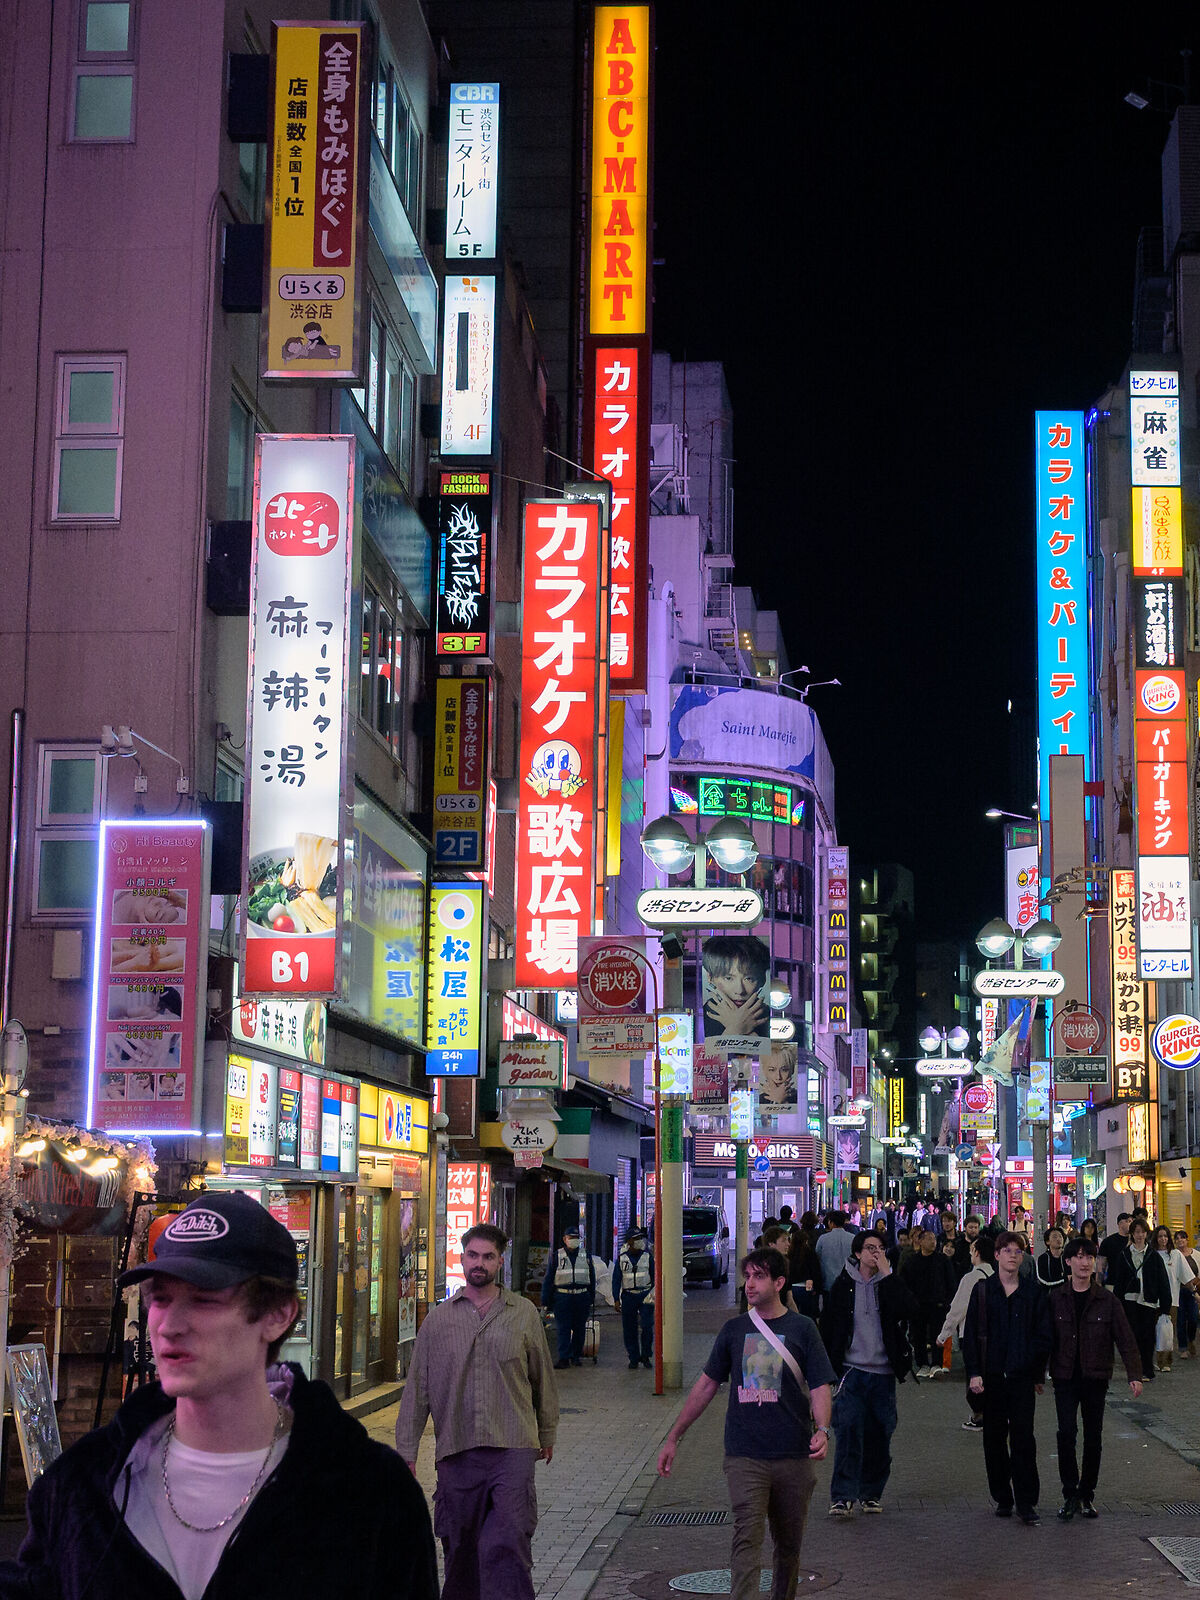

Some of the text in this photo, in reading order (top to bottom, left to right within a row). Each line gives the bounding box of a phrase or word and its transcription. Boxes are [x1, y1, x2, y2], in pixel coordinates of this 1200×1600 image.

[454, 85, 494, 101] CBR
[284, 77, 308, 218] 店舗数全国1位
[320, 41, 353, 260] 全身もみほぐし
[479, 107, 492, 190] 渋谷センター街
[452, 107, 475, 236] モニタールーム
[458, 244, 482, 256] 5F
[285, 280, 338, 294] りらくる
[290, 303, 333, 320] 渋谷店
[1131, 376, 1177, 391] センタービル
[1164, 399, 1178, 409] 5F
[463, 424, 487, 440] 4F
[1142, 411, 1169, 470] 麻雀
[451, 475, 480, 484] ROCK
[443, 484, 488, 494] FASHION
[1151, 567, 1165, 576] 4F
[530, 505, 589, 735] カラオケ
[1144, 582, 1169, 666] 一軒め酒場
[443, 636, 482, 652] 3F
[261, 595, 310, 788] 麻辣湯
[312, 619, 334, 760] マーラータン
[1145, 683, 1174, 697] BURGER
[1147, 689, 1176, 705] KING
[721, 720, 756, 734] Saint
[463, 687, 479, 786] 全身もみほぐし
[1151, 728, 1173, 849] バーガーキング
[438, 797, 477, 810] りらくる
[703, 784, 772, 813] 金ちゃん
[438, 814, 477, 830] 渋谷店
[152, 836, 196, 848] Beauty
[442, 836, 474, 856] 2F
[526, 802, 584, 974] 歌広場
[642, 899, 755, 914] 渋谷センター街
[1113, 900, 1127, 945] サワー
[270, 950, 310, 984] B1
[439, 935, 471, 998] 松屋
[594, 970, 638, 992] 消火栓
[980, 978, 1061, 989] 渋谷センター街
[448, 1012, 458, 1041] カレー
[458, 1007, 469, 1037] 牛めし
[437, 1018, 447, 1045] 定食
[1063, 1023, 1096, 1039] 消火栓
[1160, 1024, 1200, 1045] BURGER
[714, 1039, 762, 1048] 渋谷センター街
[1119, 1037, 1141, 1052] 99
[441, 1051, 463, 1060] 24h
[501, 1052, 548, 1066] Miami
[1118, 1067, 1143, 1088] B1
[519, 1126, 540, 1136] てんぐ
[512, 1134, 545, 1146] 大ホール
[186, 1214, 218, 1232] Dutch
